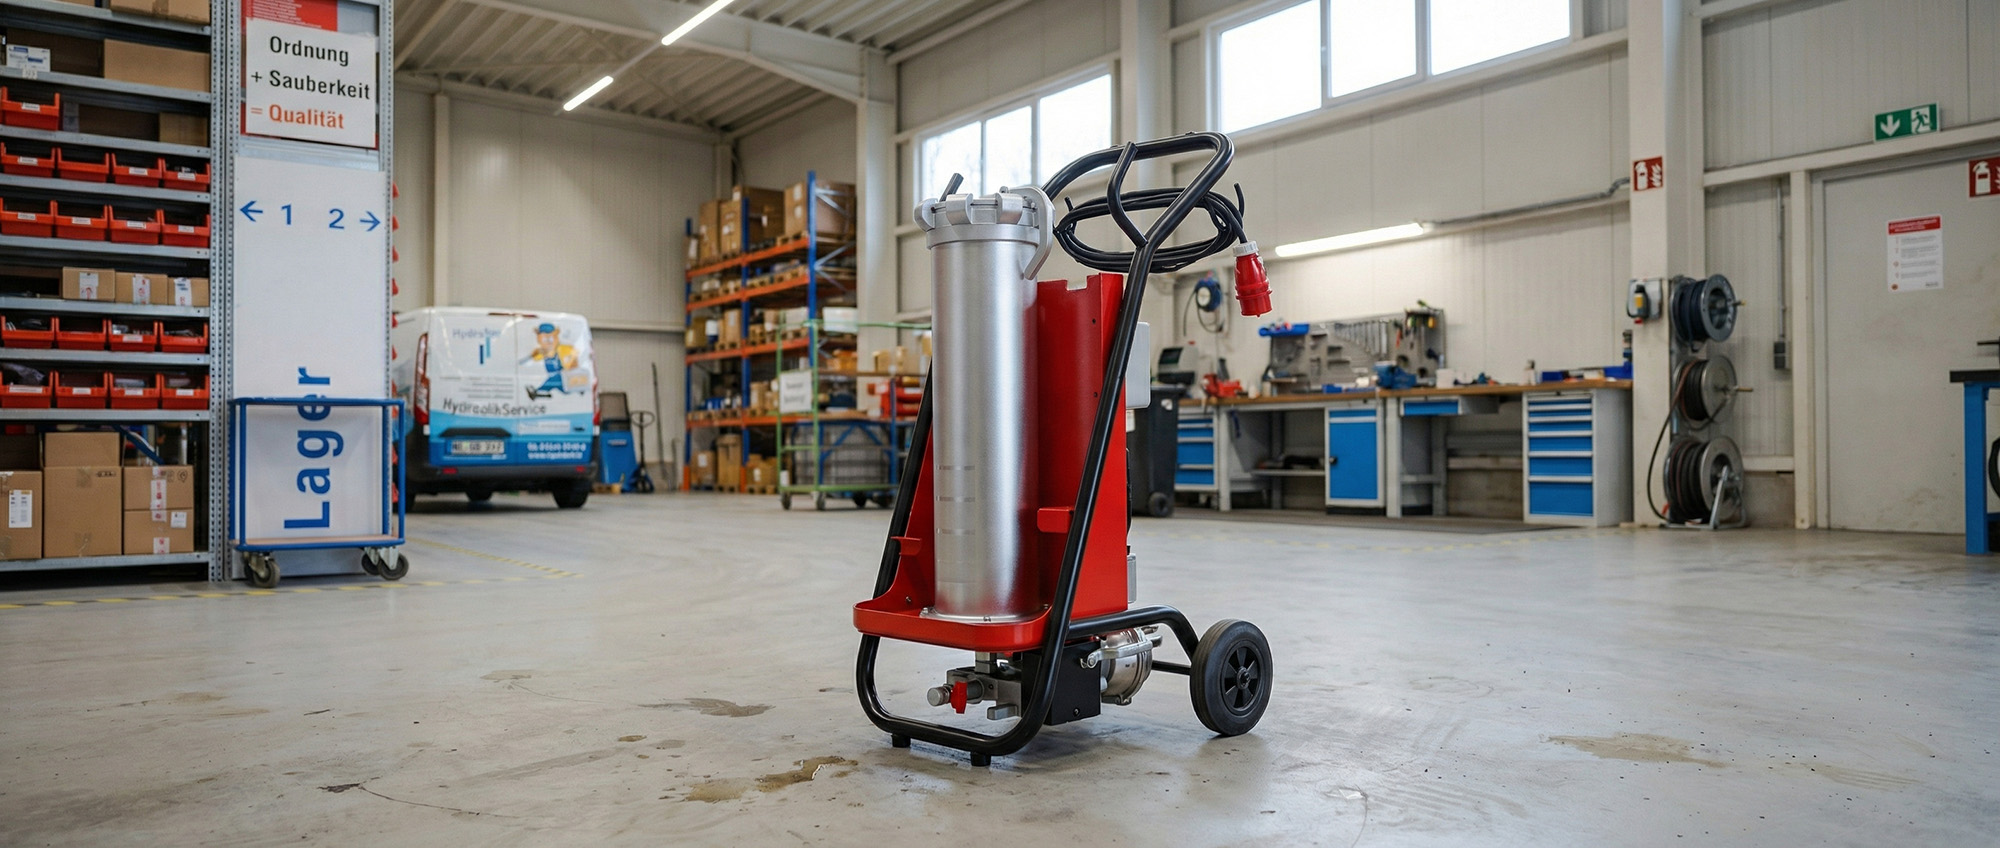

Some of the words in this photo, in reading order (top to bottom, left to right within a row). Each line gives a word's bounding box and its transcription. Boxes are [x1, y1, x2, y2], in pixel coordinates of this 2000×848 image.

[269, 36, 349, 67] Ordnung
[269, 70, 371, 100] Sauberkeit
[269, 104, 345, 130] Qualität
[281, 204, 292, 225] 1
[328, 208, 345, 229] 2
[283, 366, 344, 529] Lager
